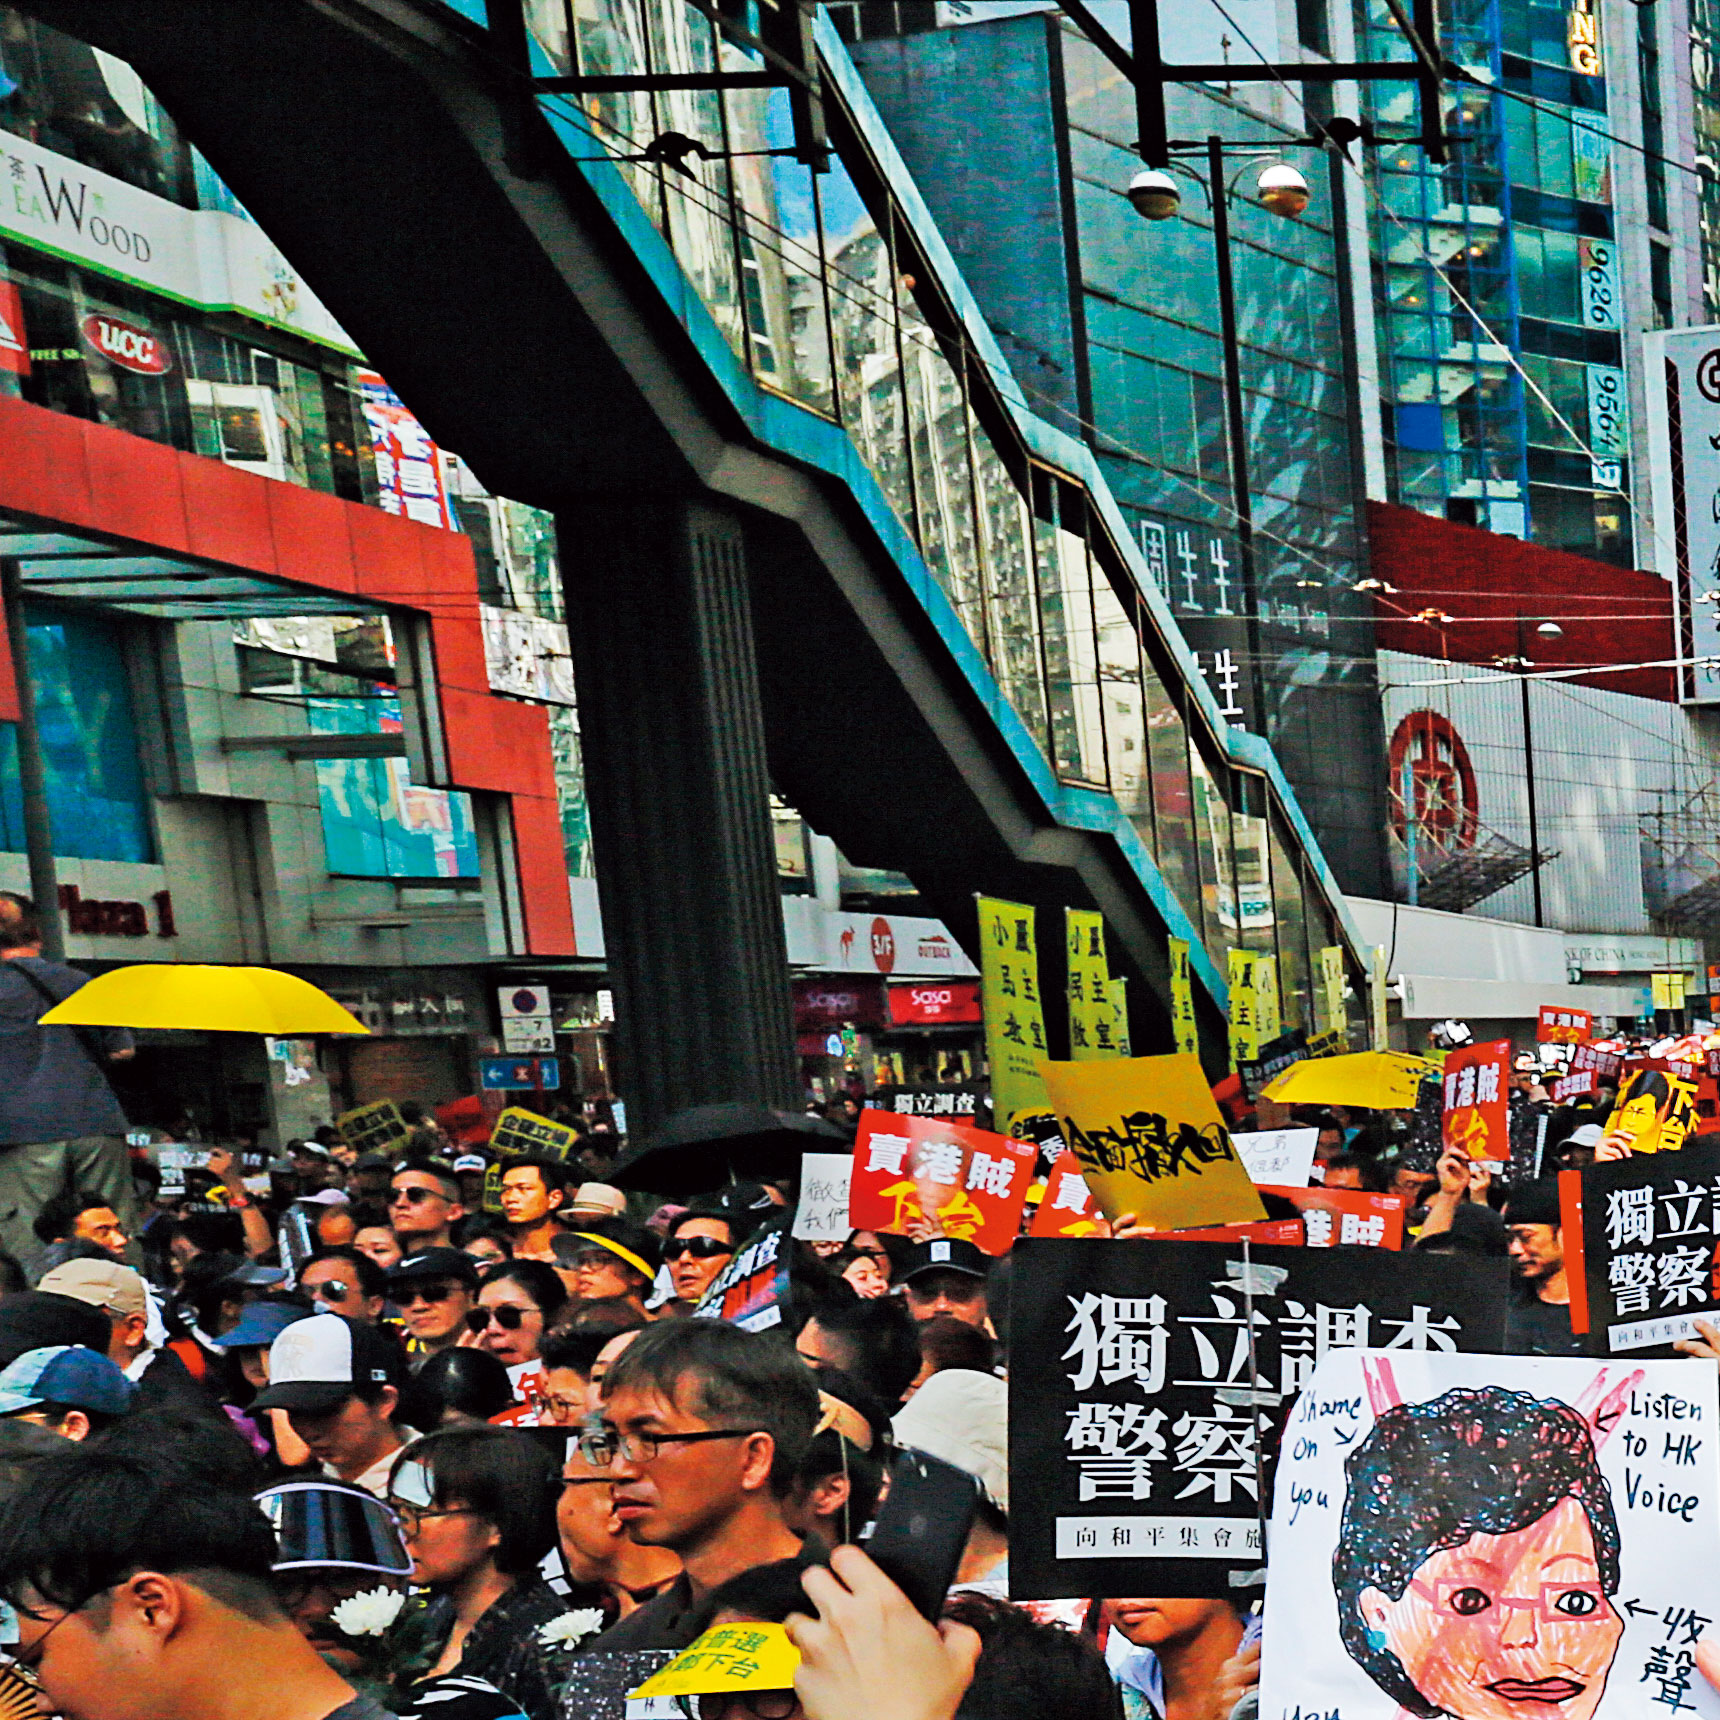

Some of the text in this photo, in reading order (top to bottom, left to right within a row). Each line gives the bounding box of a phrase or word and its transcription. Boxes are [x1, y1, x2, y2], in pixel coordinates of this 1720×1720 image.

[36, 163, 151, 263] WOOD
[1586, 247, 1611, 325] 9626
[98, 320, 154, 364] UCC
[917, 945, 951, 960] OUTBACK
[894, 1093, 977, 1114] 獨立調查
[863, 1132, 1017, 1199] 賣港賊
[1296, 1394, 1361, 1425] Shame
[1629, 1393, 1704, 1424] Listen
[1061, 1399, 1275, 1505] 警察
[1622, 1430, 1703, 1468] to HK
[1290, 1486, 1330, 1525] you
[1625, 1473, 1701, 1523] Voice
